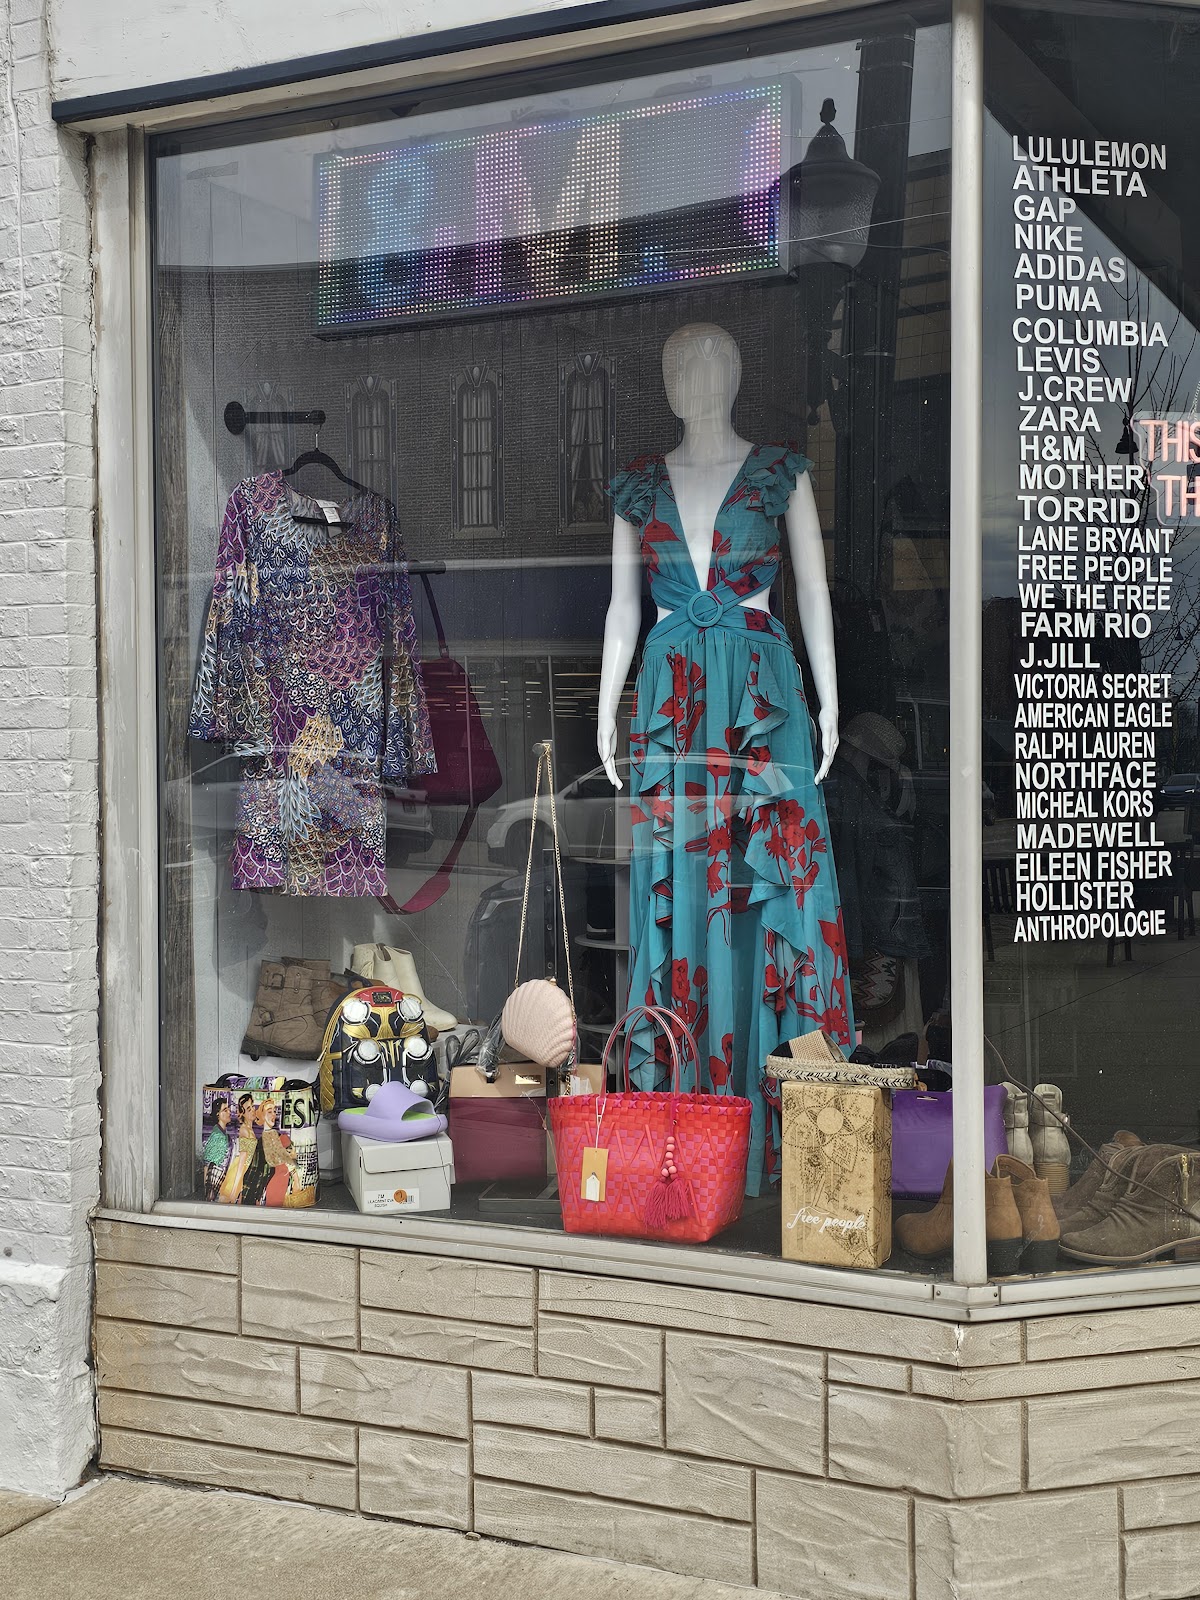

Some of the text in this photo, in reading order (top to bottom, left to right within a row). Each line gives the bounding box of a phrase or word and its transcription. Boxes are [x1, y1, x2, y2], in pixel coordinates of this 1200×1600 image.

[1012, 135, 1167, 170] LULULEMON
[1012, 164, 1148, 198] ATHLETA
[1013, 194, 1077, 223] GAP
[1014, 223, 1084, 252] NIKE
[1013, 252, 1126, 283] ADIDAS
[1016, 283, 1103, 313] PUMA
[1012, 316, 1169, 347] COLUMBIA
[1017, 345, 1101, 374] LEVIS
[1018, 375, 1132, 403] J.CREW
[1018, 405, 1102, 433] ZARA
[1020, 434, 1086, 462] H&M
[1019, 463, 1146, 490] MOTHER
[1017, 494, 1141, 524] TORRID
[1018, 525, 1175, 554] LANE BRYANT
[1017, 554, 1174, 583] FREE PEOPLE
[1018, 582, 1171, 611] WE THE FREE
[1021, 611, 1152, 639] FARM RIO
[1019, 642, 1101, 669] J.JILL
[1013, 673, 1172, 700] VICTORIA SECRET
[1014, 702, 1173, 729] AMERICAN EAGLE
[1015, 731, 1155, 760] RALPH LAUREN
[1015, 760, 1157, 790] NORTHFACE
[1016, 790, 1154, 819] MICHEAL KORS
[1017, 821, 1165, 850] MADEWELL
[1015, 850, 1173, 882] EILEEN FISHER
[1016, 881, 1135, 912] HOLLISTER
[1013, 909, 1166, 943] ANTHROPOLOGIE
[786, 1206, 867, 1234] free people
